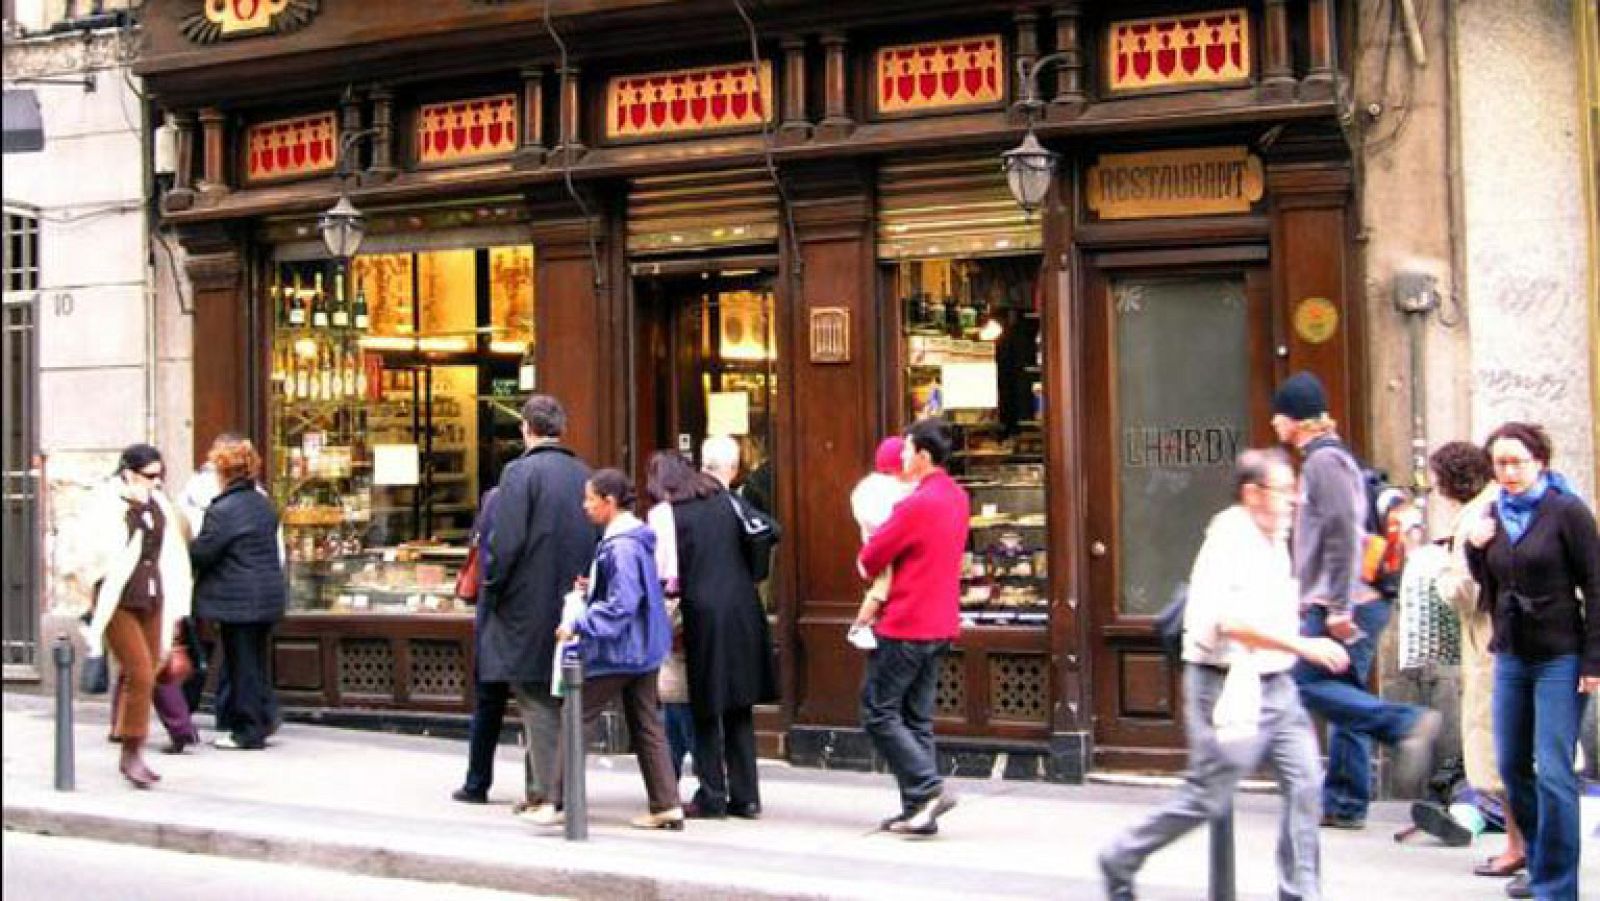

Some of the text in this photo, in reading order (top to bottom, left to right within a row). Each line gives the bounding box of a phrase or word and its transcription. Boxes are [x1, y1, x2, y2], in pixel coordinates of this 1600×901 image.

[1100, 159, 1245, 201] RESTAURANT
[54, 293, 74, 317] 10
[1126, 427, 1240, 466] LHARDY
